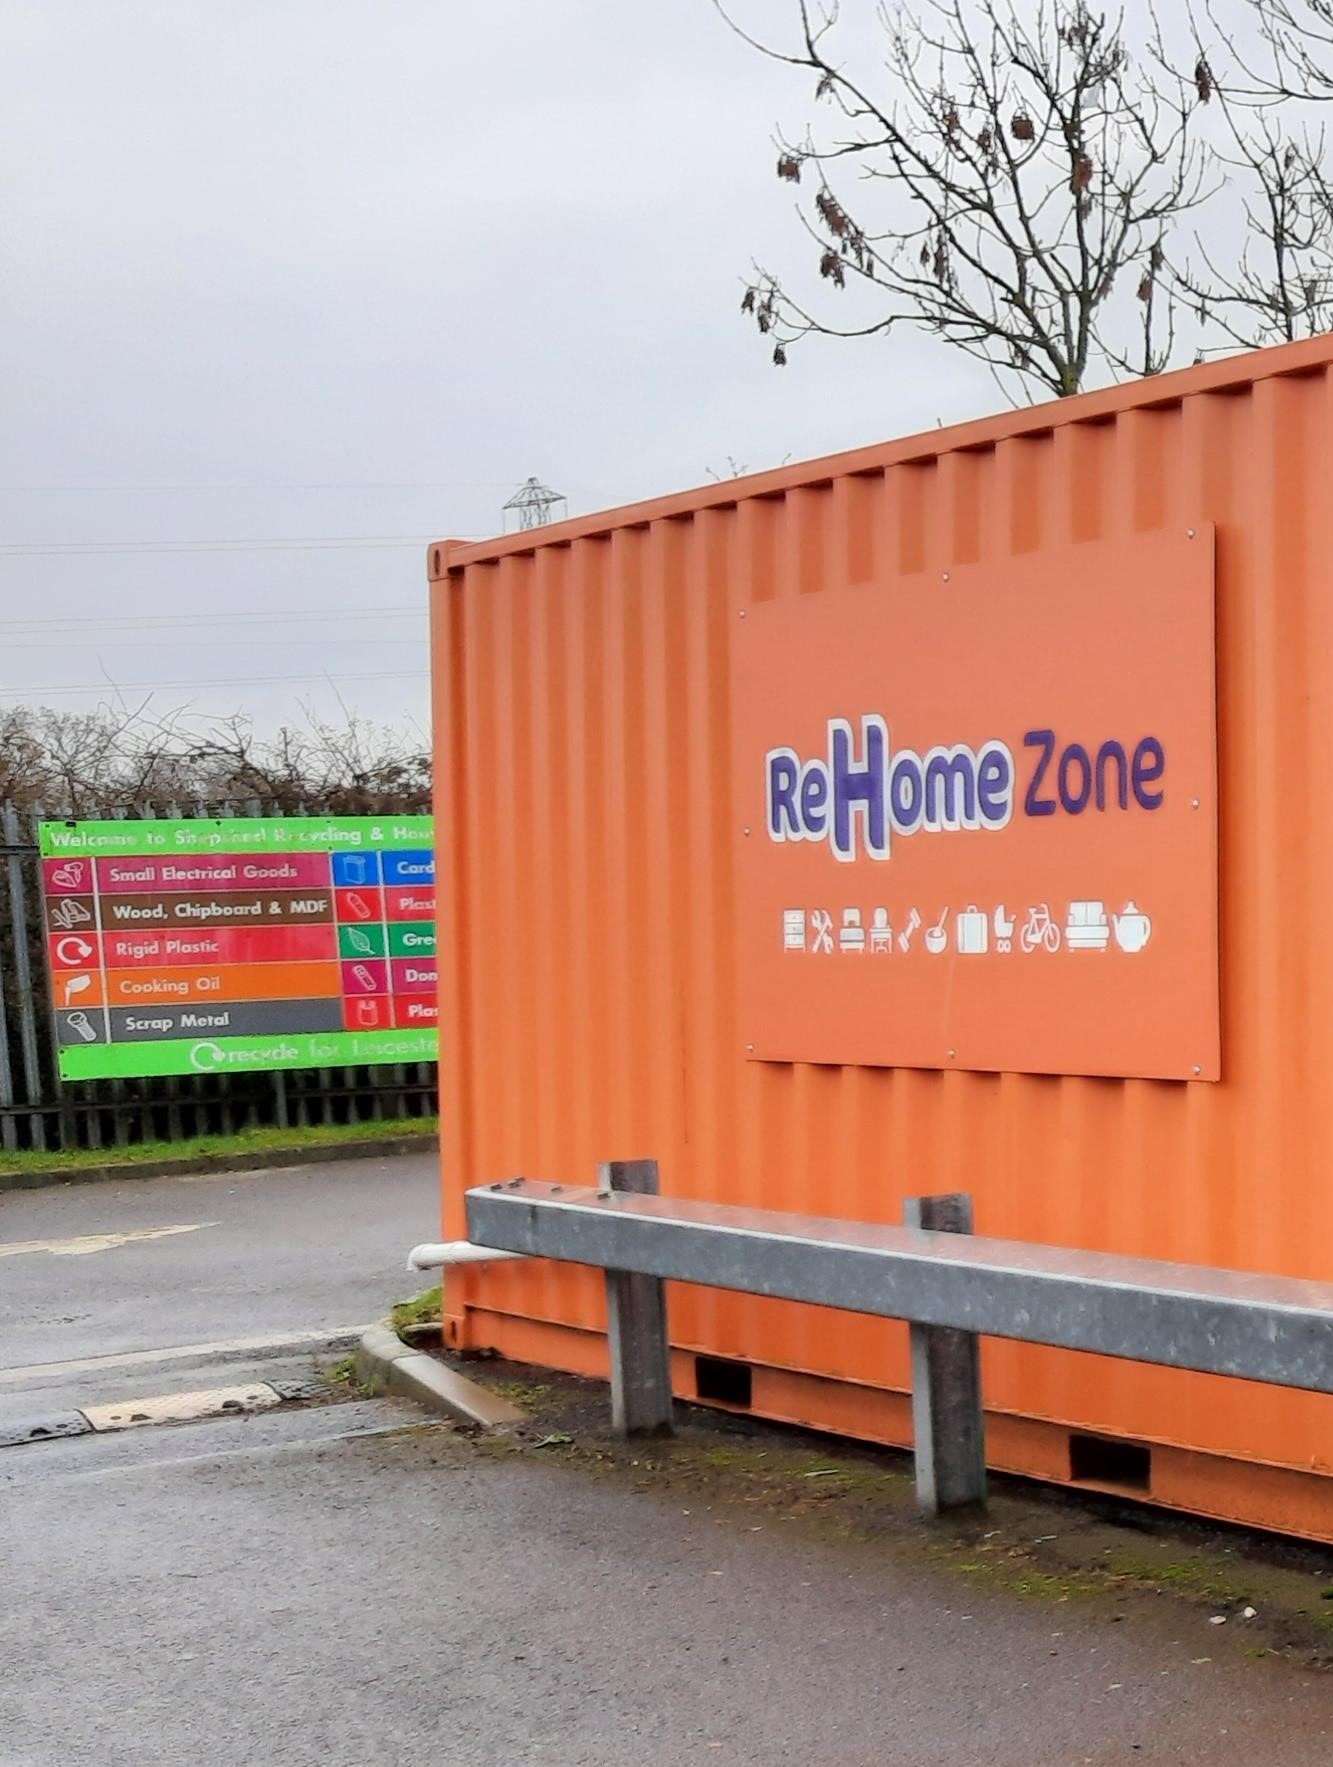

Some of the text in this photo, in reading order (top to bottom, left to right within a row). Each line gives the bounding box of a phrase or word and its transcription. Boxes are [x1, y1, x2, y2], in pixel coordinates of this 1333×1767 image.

[766, 714, 1165, 862] ReHome Zone
[51, 832, 137, 847] Welcome
[147, 832, 166, 845] to
[275, 825, 362, 845] Rcycling
[370, 827, 384, 840] &
[109, 863, 298, 882] Small Electrical Goods
[113, 899, 329, 920] Wood, Chipboard & MDF
[116, 939, 220, 959] Rigid Plastic
[120, 976, 221, 995] Cooking Oil
[125, 1011, 230, 1033] Scrap Metal
[228, 1042, 300, 1064] recycle
